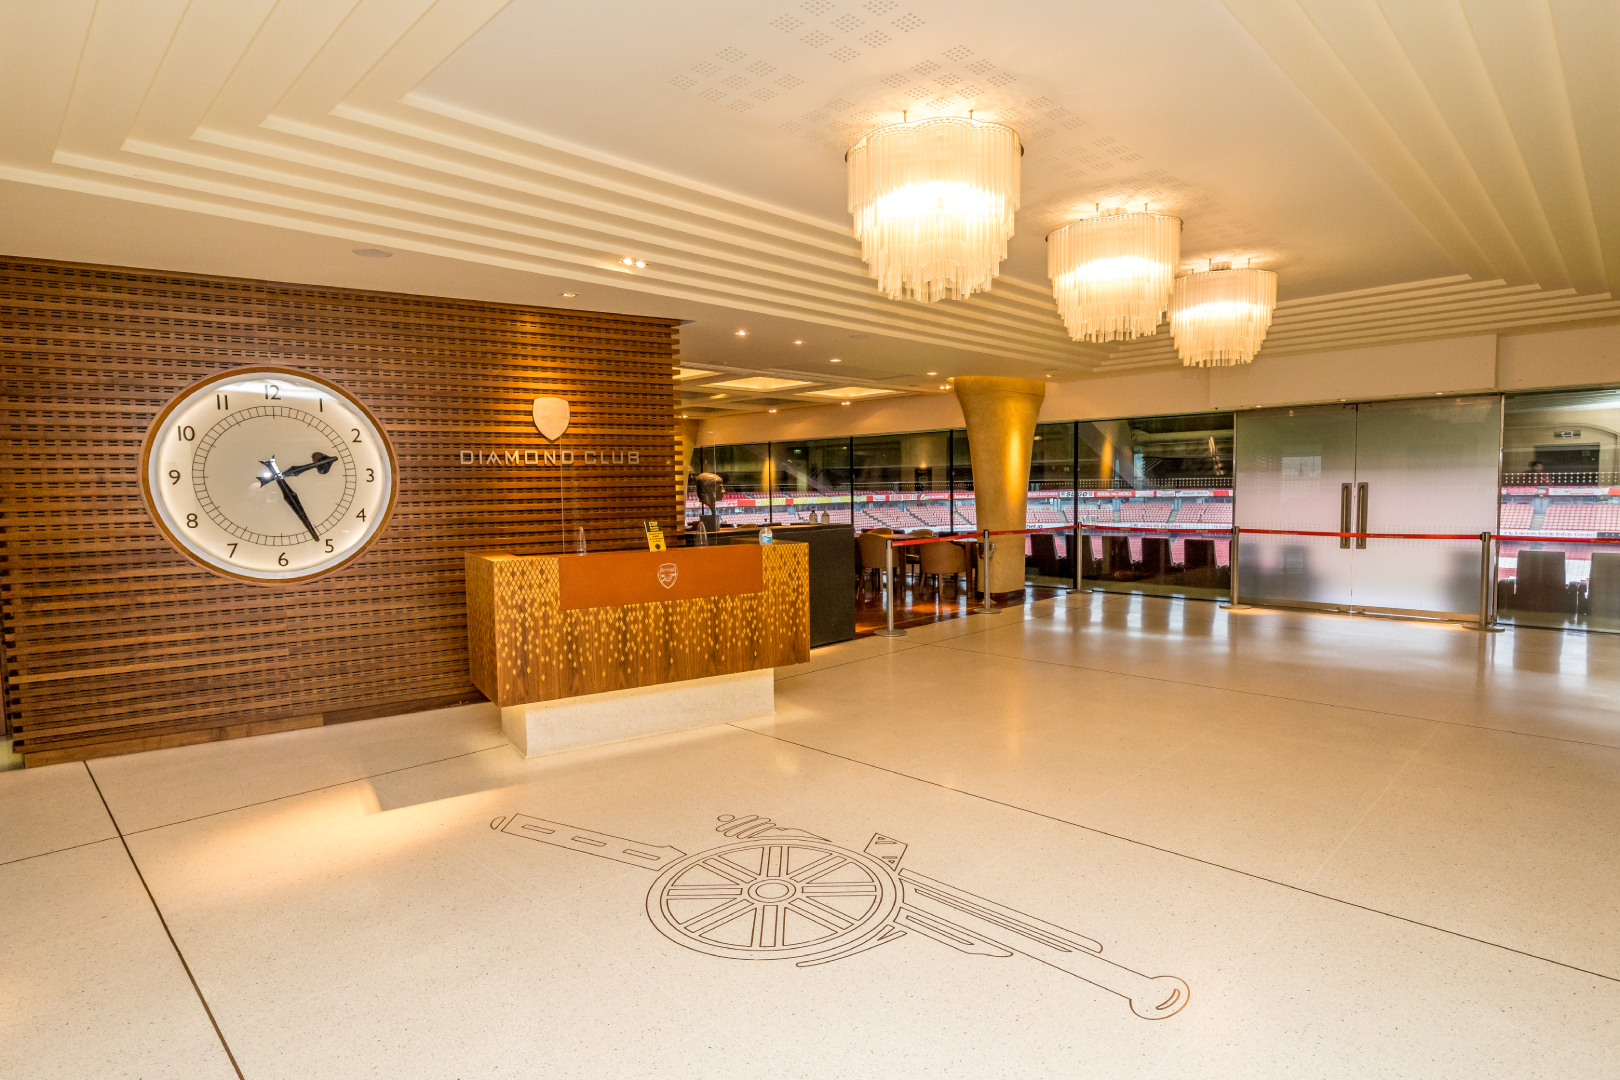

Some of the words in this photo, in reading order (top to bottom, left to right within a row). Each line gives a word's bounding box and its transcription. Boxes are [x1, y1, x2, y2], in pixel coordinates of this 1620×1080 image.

[264, 384, 282, 400] 12
[216, 394, 229, 410] 11
[318, 398, 323, 412] 1
[177, 425, 195, 441] 10
[350, 428, 362, 443] 2
[460, 450, 574, 465] DIAMOND
[584, 451, 640, 465] CLUB
[168, 469, 181, 485] 9
[365, 468, 375, 483] 3
[186, 513, 198, 528] 8
[355, 508, 366, 522] 4
[226, 542, 238, 558] 7
[324, 538, 334, 553] 5
[278, 552, 289, 566] 6
